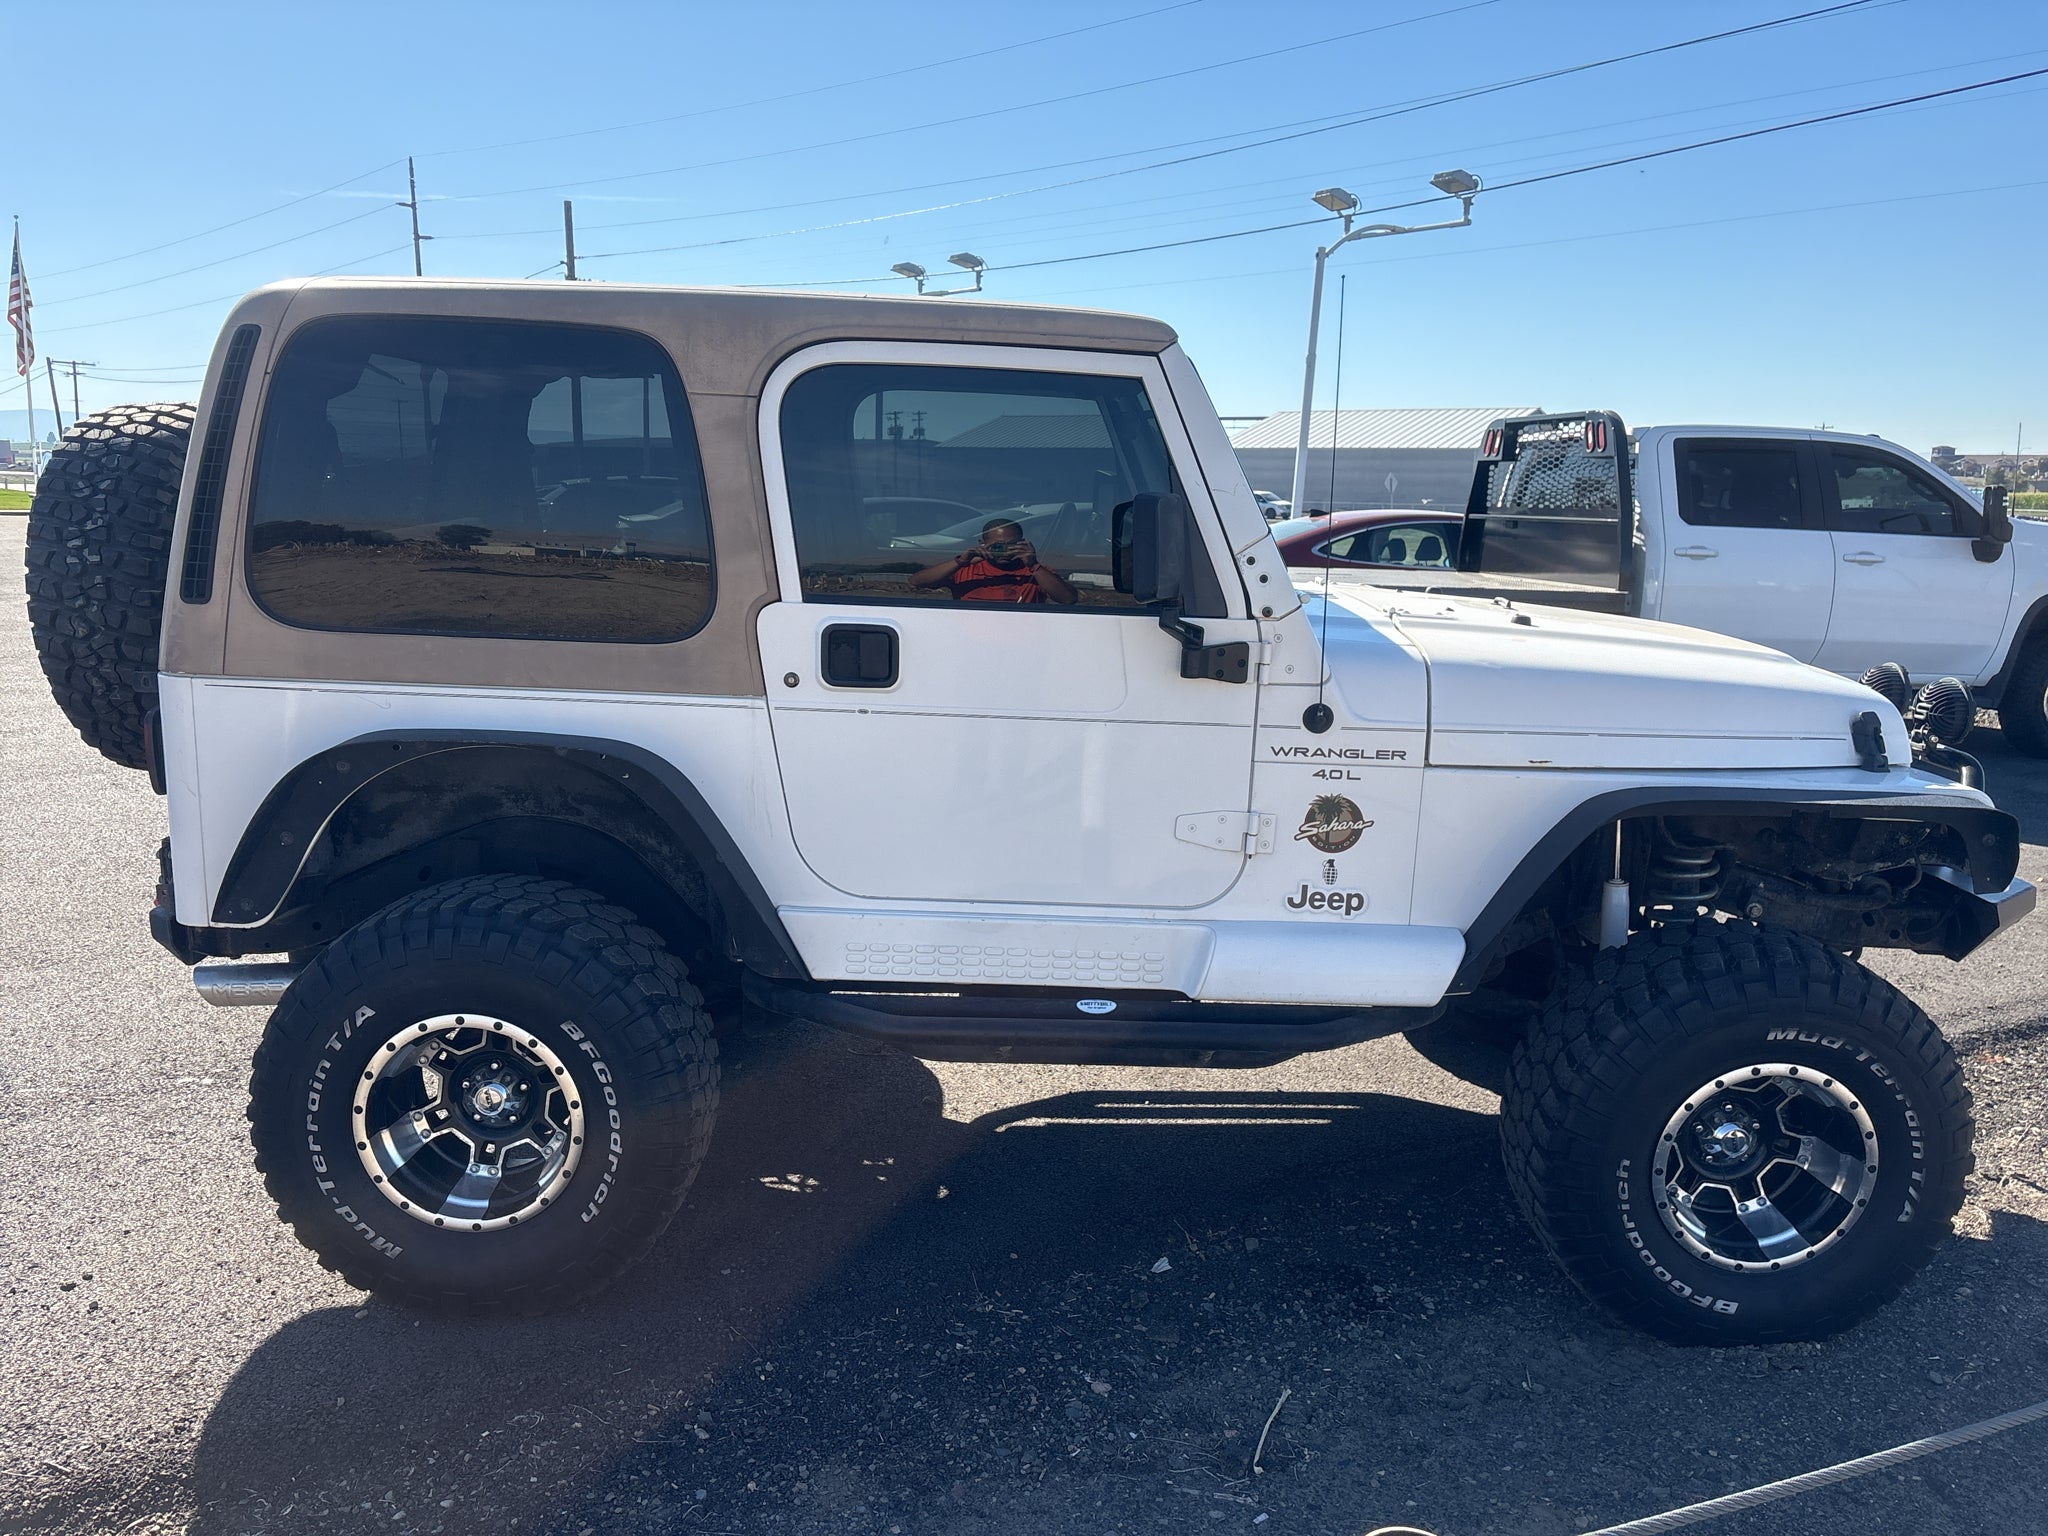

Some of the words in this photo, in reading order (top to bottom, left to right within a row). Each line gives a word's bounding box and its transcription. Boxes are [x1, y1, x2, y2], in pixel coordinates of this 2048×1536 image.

[1270, 746, 1407, 761] WRANGLER
[1295, 816, 1374, 841] Sahara
[1312, 836, 1356, 850] EDITION
[1287, 884, 1365, 916] Jeep
[212, 982, 286, 998] MBRP
[325, 1005, 376, 1051] T/A
[560, 1020, 623, 1223] BFGoodrich
[306, 1059, 403, 1260] Mud-Terrain
[1896, 1167, 1926, 1223] T/A
[1616, 1159, 1740, 1315] BFGoodrich
